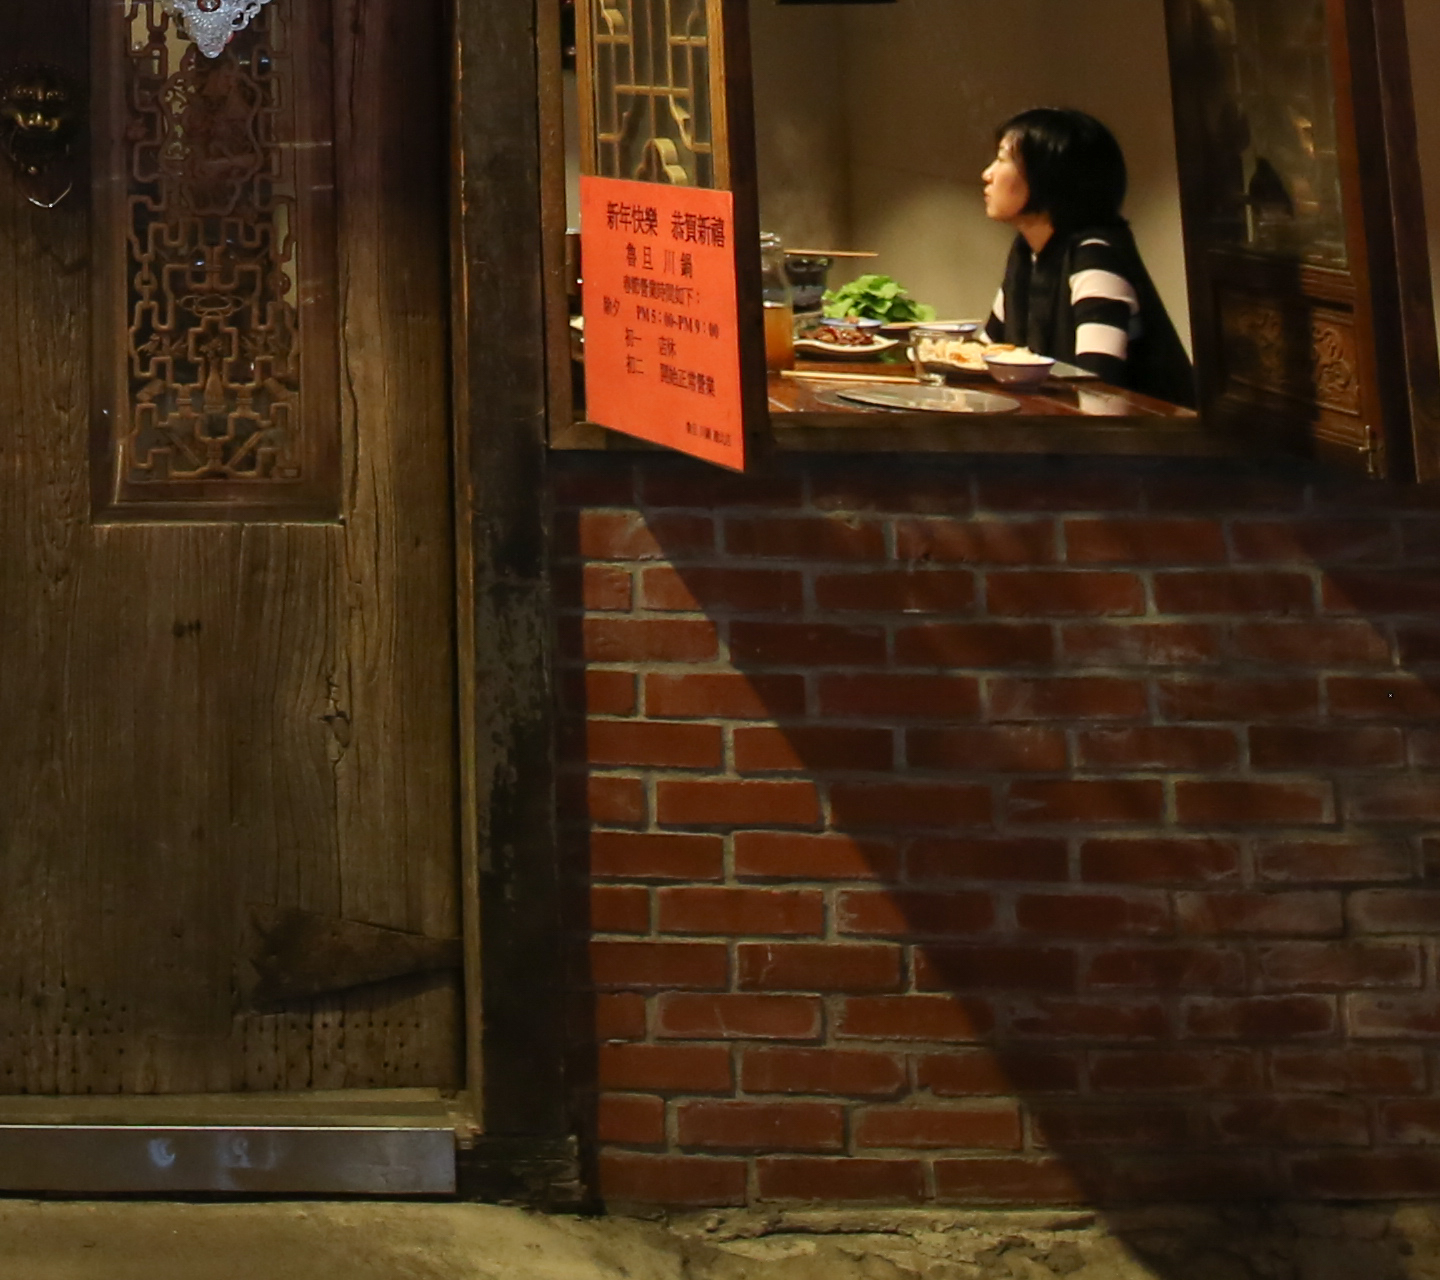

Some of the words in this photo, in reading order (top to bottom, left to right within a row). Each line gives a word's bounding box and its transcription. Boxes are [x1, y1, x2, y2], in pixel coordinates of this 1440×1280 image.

[607, 200, 658, 237] 新年快樂
[671, 209, 725, 248] 恭賀新禧
